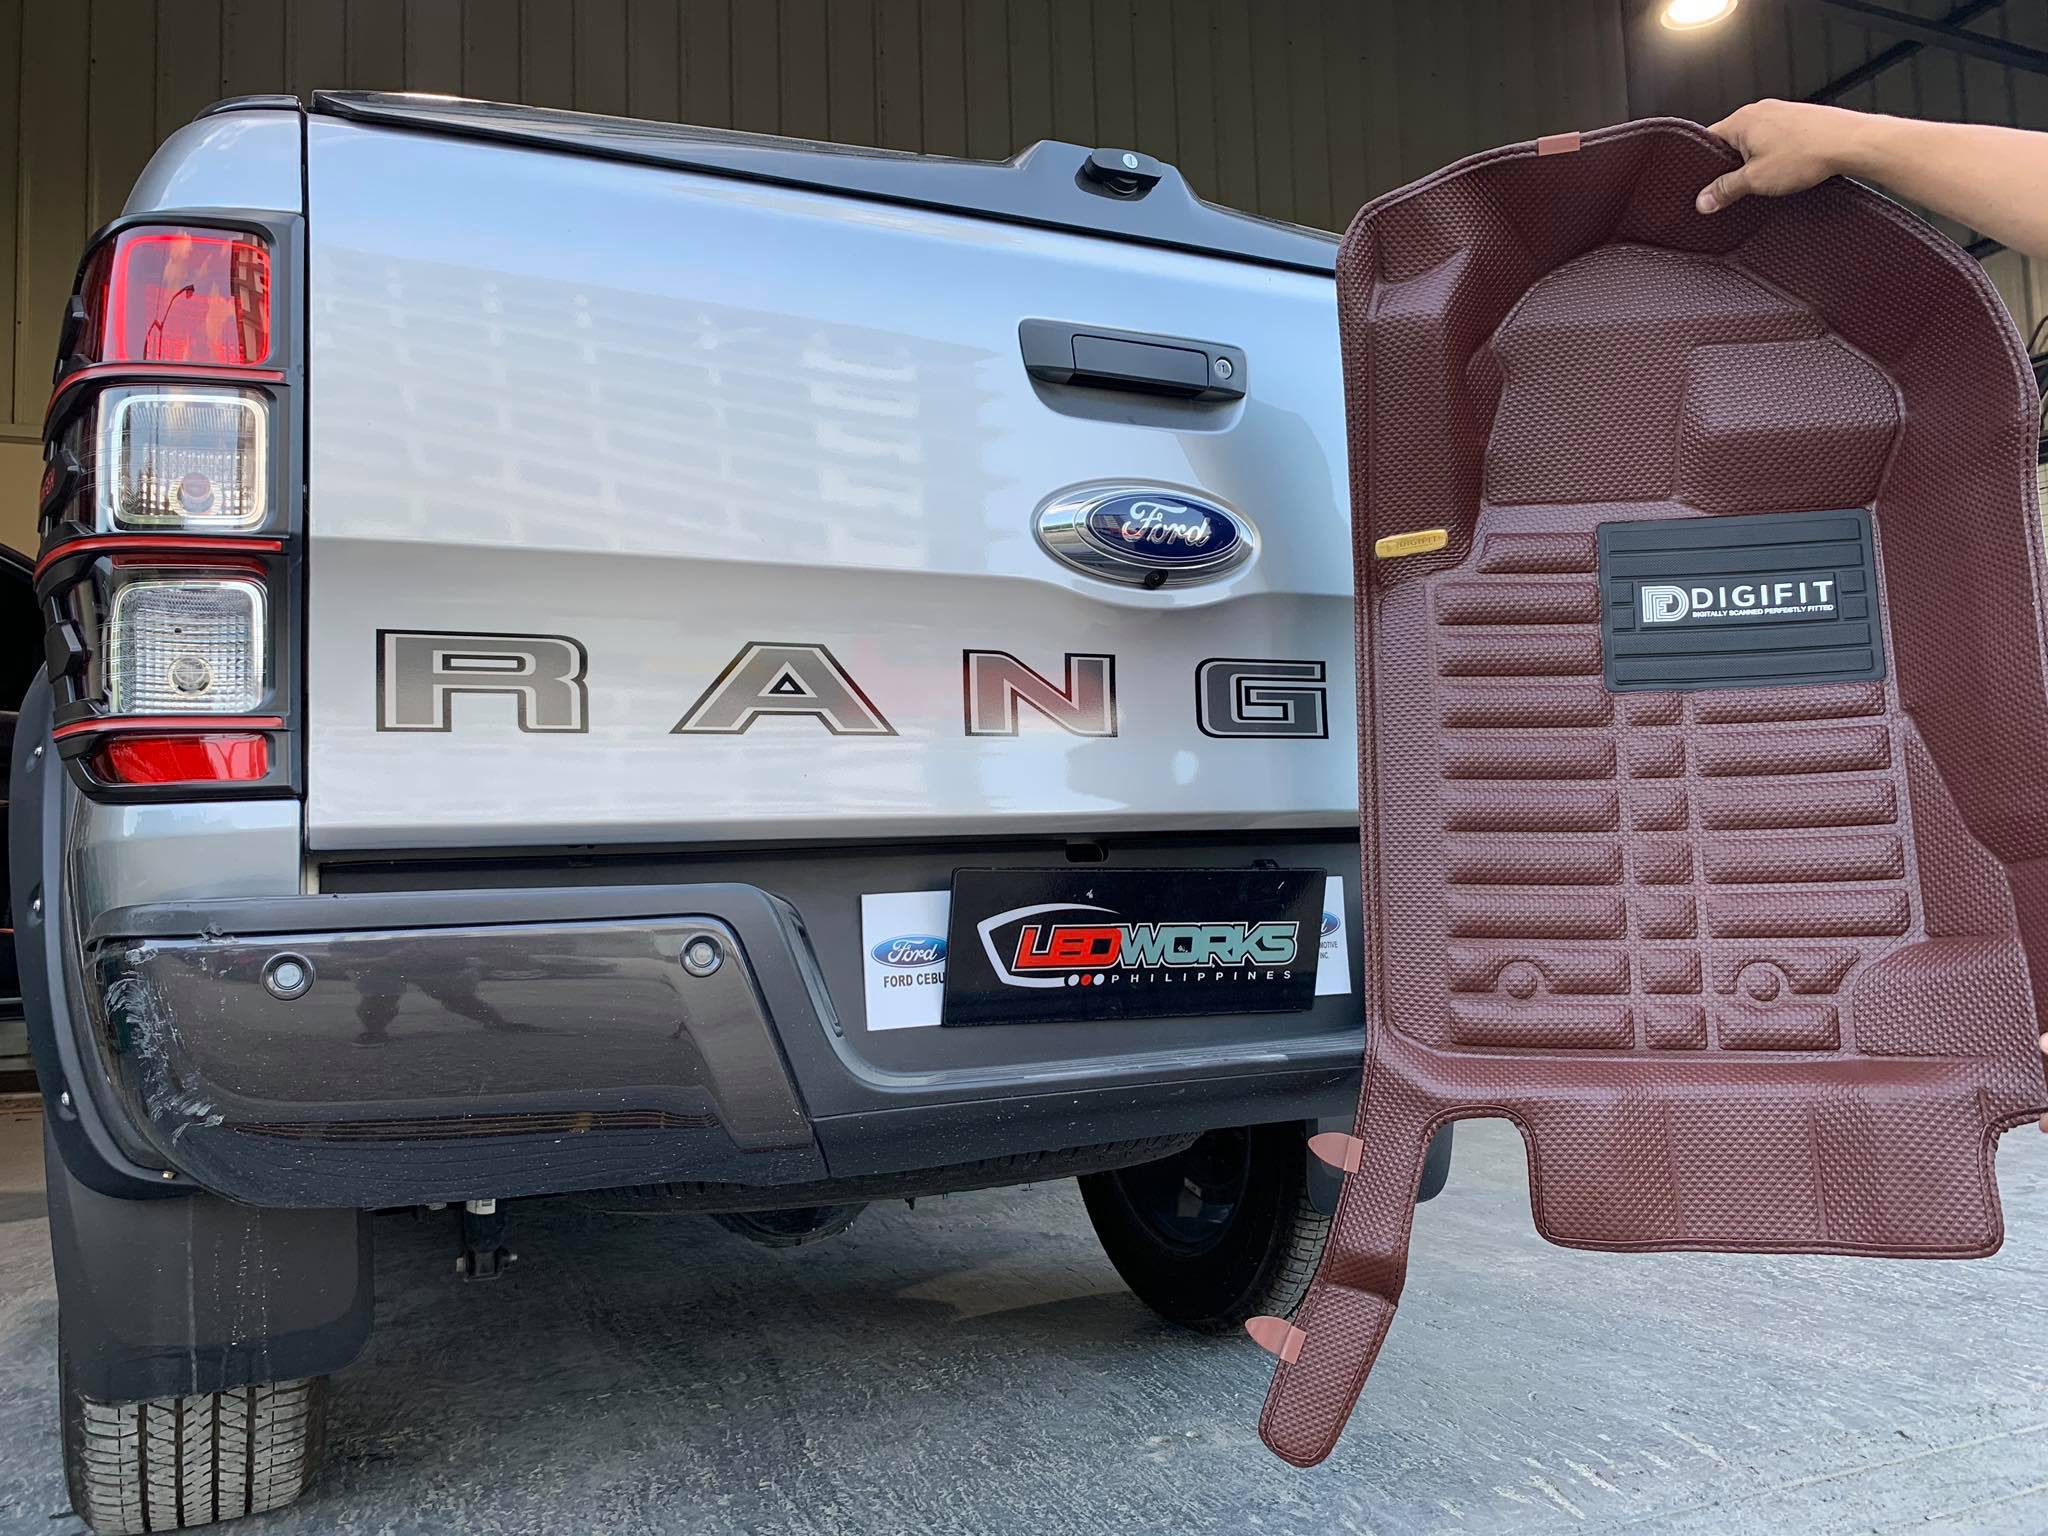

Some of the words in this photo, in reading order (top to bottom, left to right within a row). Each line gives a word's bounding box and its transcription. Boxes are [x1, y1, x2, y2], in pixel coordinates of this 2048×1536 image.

[1121, 501, 1212, 547] Ford
[1691, 580, 1834, 609] DIGIFIT
[1692, 609, 1728, 618] DIGITALLY
[1728, 607, 1763, 616] SCANNED
[1764, 606, 1806, 615] PERFECTLY
[1808, 604, 1834, 612] FITTED
[887, 938, 939, 963] Ford
[883, 974, 913, 988] FORD
[917, 971, 945, 986] CEBU
[1111, 970, 1292, 985] PHILIPPINES
